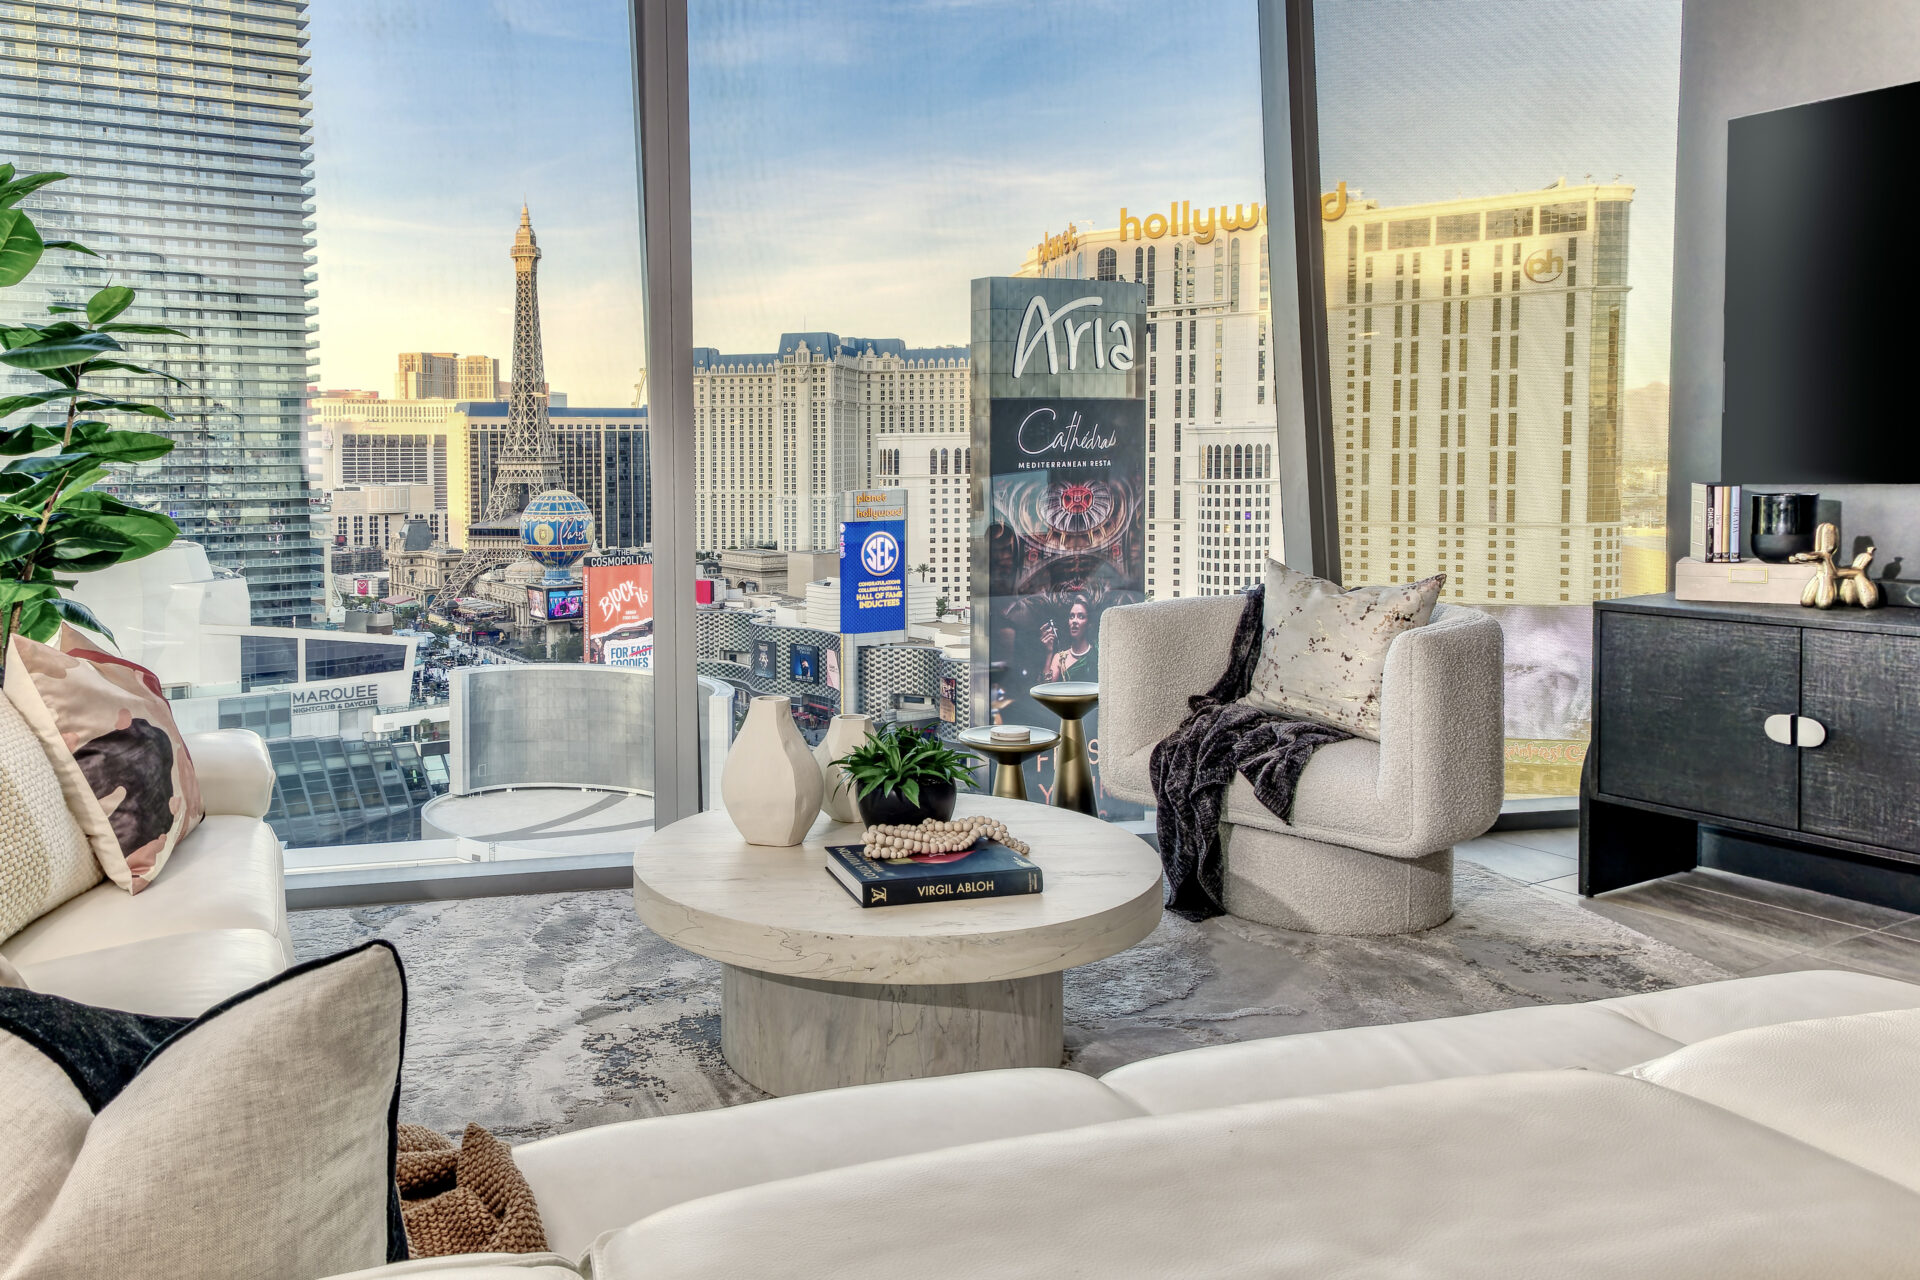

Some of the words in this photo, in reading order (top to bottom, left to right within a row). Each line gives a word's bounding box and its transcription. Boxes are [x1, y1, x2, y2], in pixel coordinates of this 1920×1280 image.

[1119, 181, 1347, 244] hollywd
[1013, 295, 1135, 379] Aria
[1018, 460, 1087, 470] MEDITERRANEAN
[1089, 459, 1112, 468] RESTA
[856, 493, 887, 506] planet
[856, 507, 903, 520] hollywood
[1707, 507, 1715, 530] CHANEL
[559, 516, 587, 549] Paris
[590, 554, 653, 568] COSMOPOLITAN
[866, 536, 894, 572] SEC
[856, 593, 874, 601] HALL
[875, 592, 884, 600] OF
[885, 590, 903, 599] FAME
[858, 598, 901, 609] INDUCTEES
[610, 647, 628, 659] FOR
[293, 684, 378, 705] MARQUEE
[293, 703, 336, 714] NIGHTCLUB
[344, 699, 378, 709] DAYCLUB
[917, 884, 954, 897] VIRGIL
[956, 880, 995, 893] ABLOH
